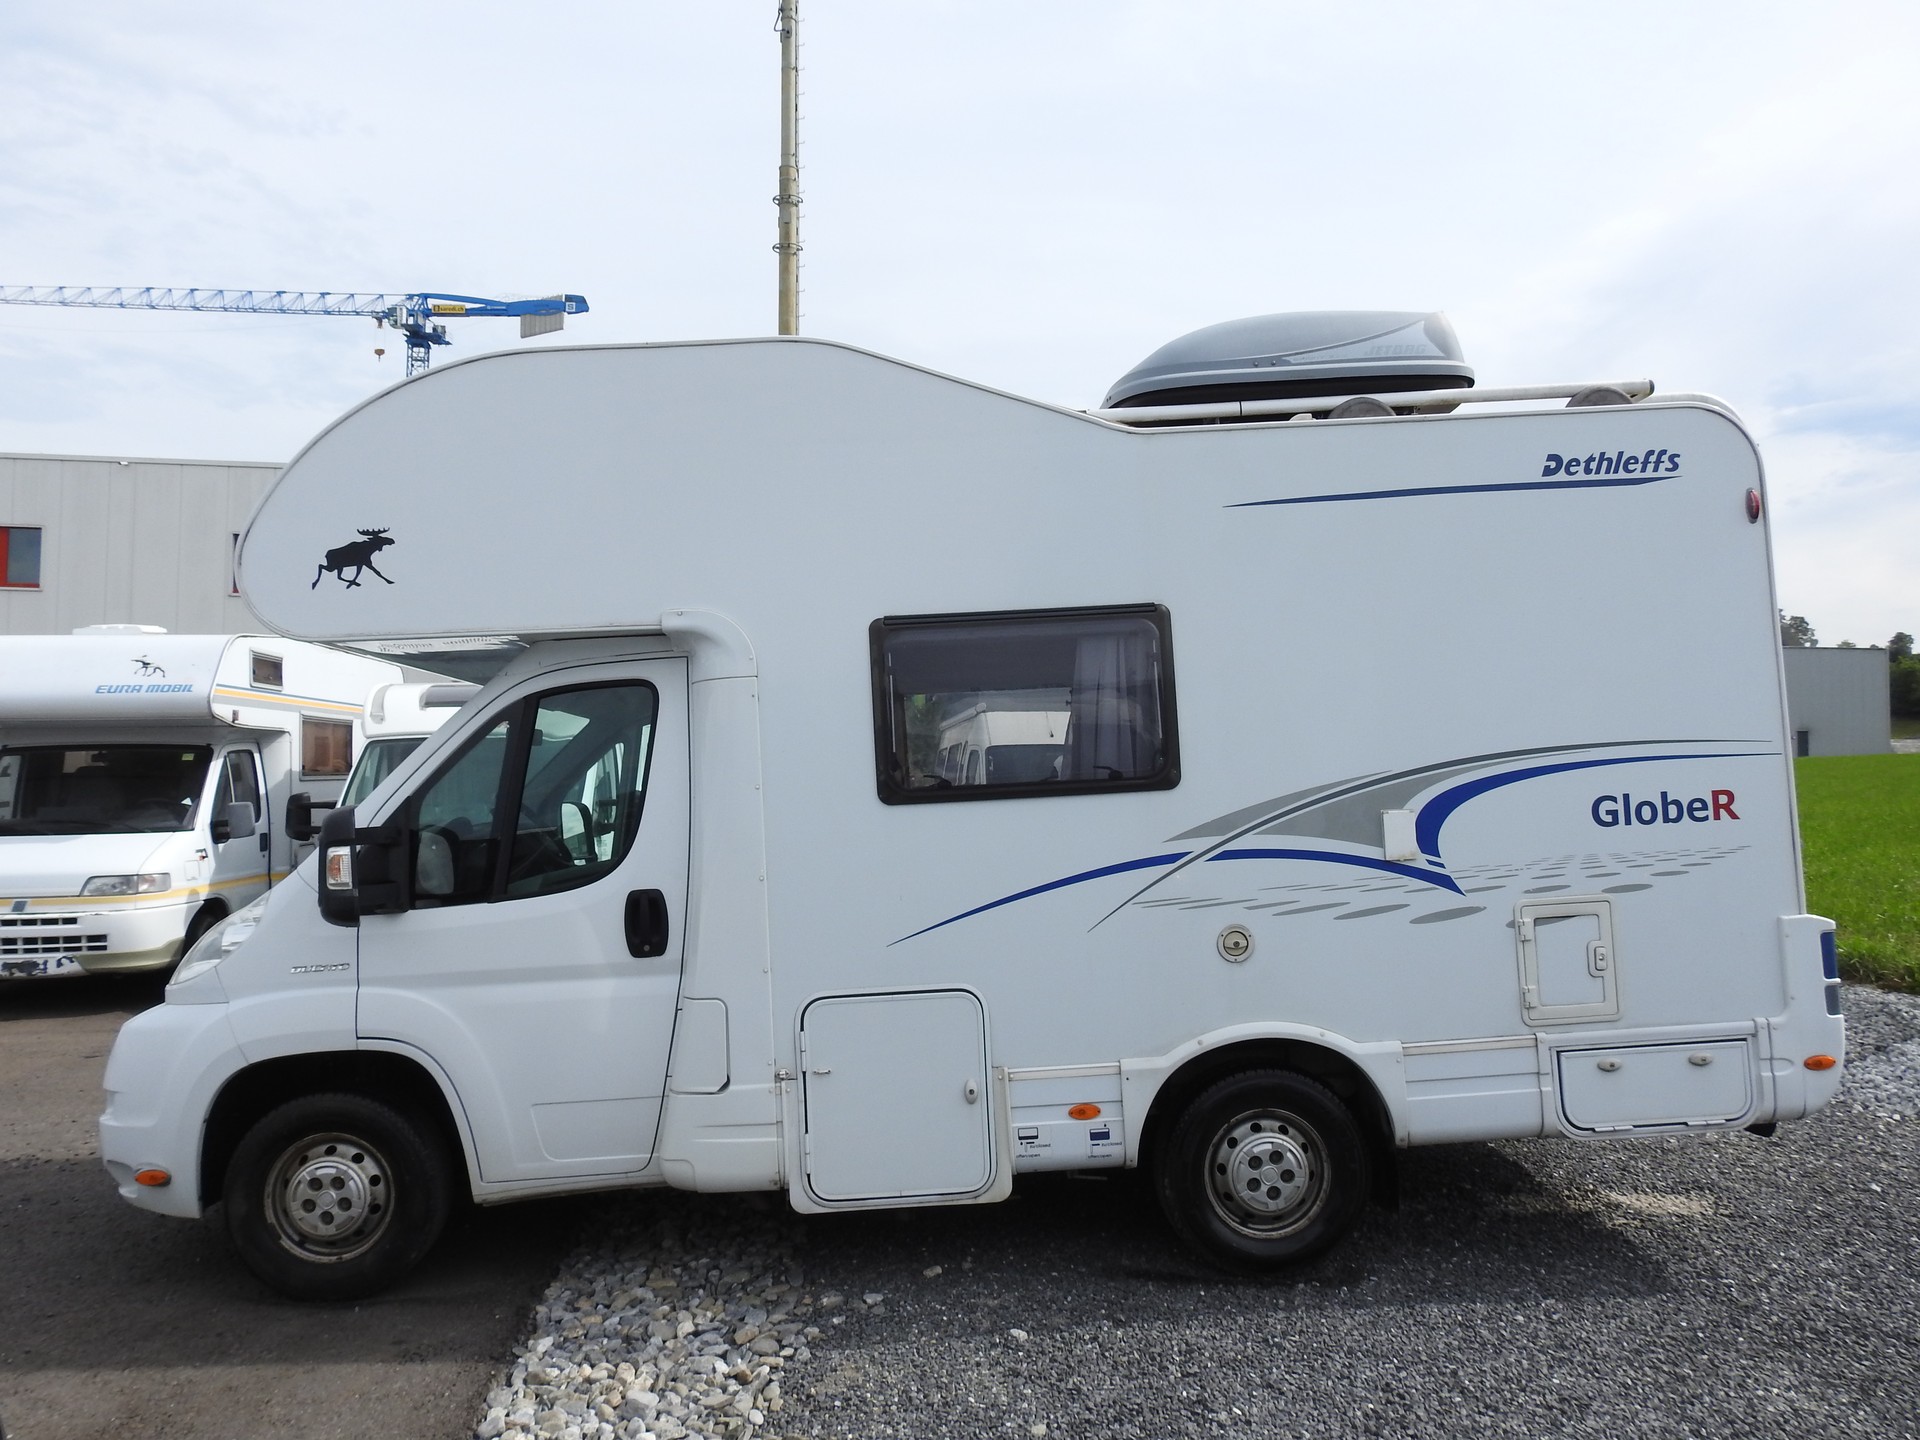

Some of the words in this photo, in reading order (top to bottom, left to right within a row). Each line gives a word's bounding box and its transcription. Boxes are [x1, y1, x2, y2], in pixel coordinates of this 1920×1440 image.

[1541, 449, 1681, 477] Dethleffs
[95, 684, 143, 694] EURA
[145, 684, 193, 694] MOBIL
[1591, 789, 1741, 828] GlobeR
